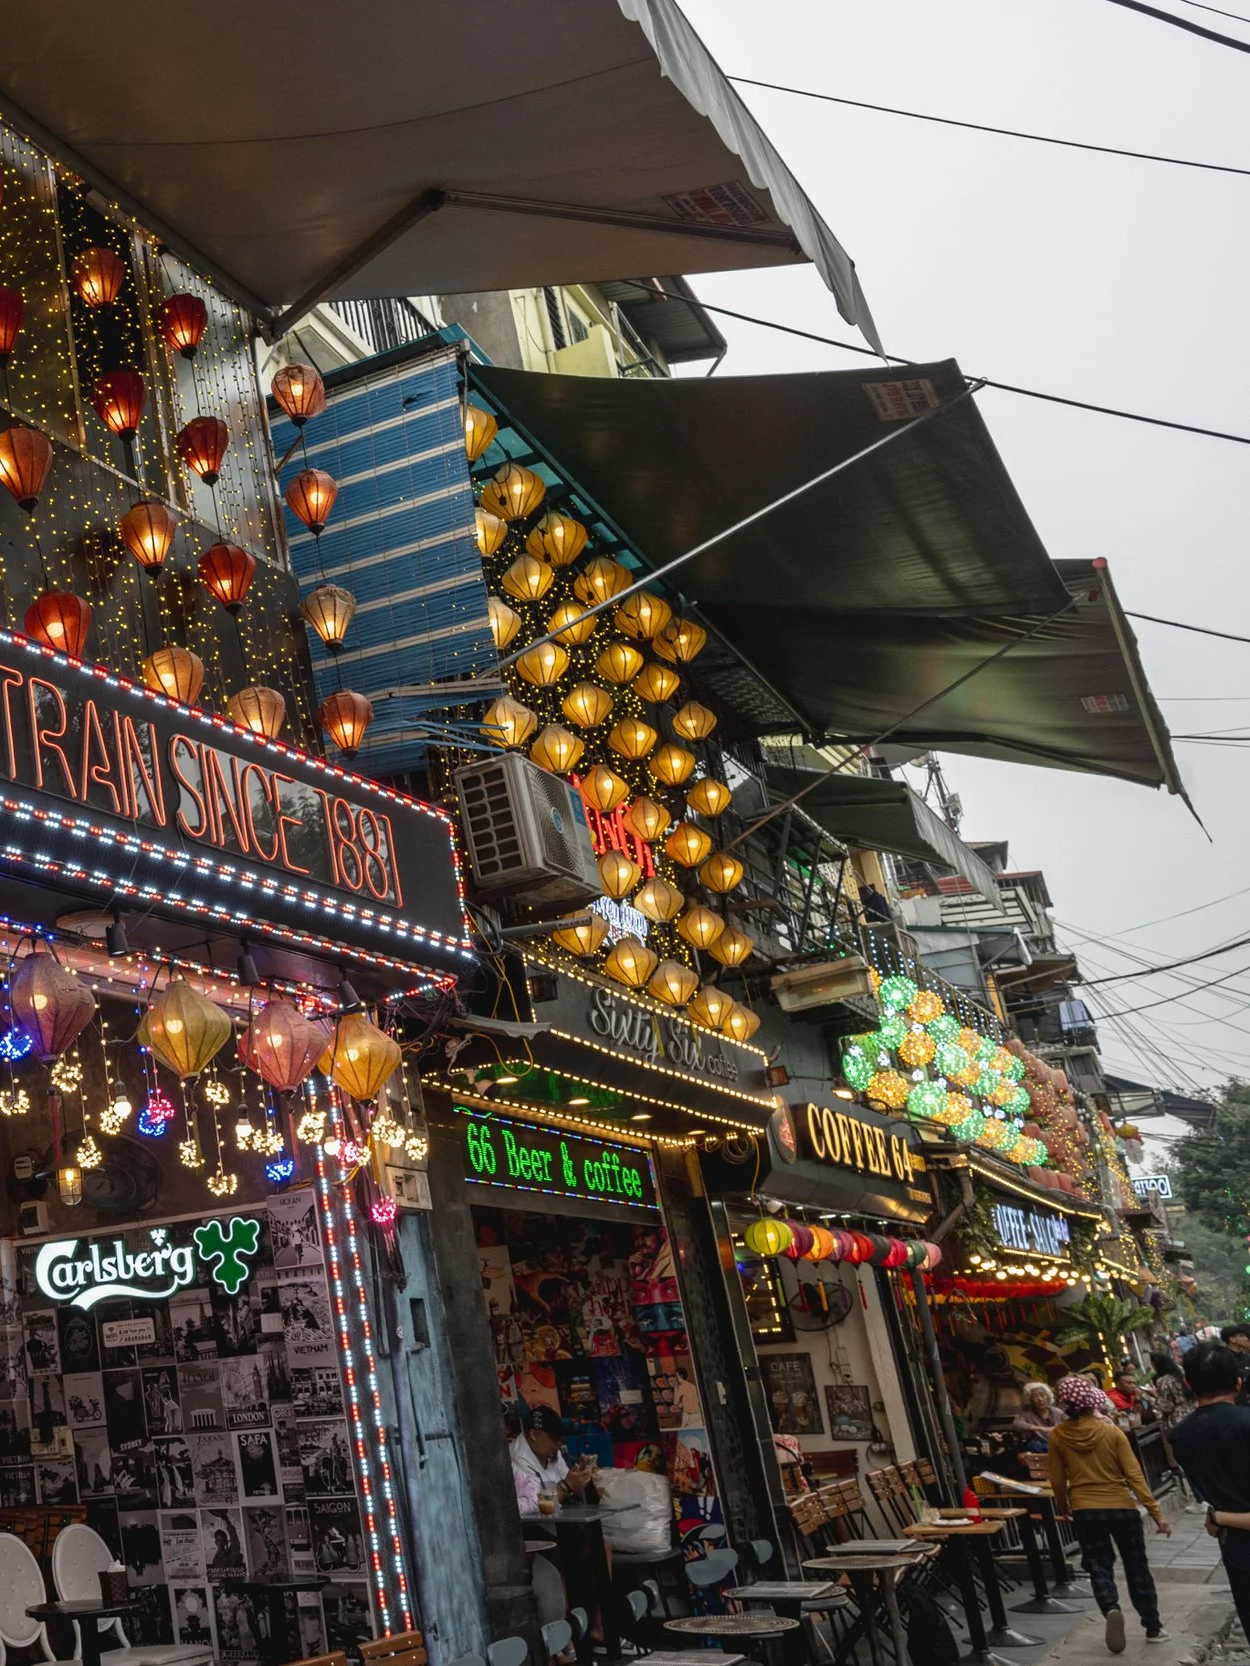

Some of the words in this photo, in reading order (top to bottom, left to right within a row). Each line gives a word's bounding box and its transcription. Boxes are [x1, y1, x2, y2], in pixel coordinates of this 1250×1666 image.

[169, 732, 311, 876] SINCE
[315, 788, 403, 909] 1881
[589, 988, 659, 1062] Sixty
[667, 1019, 706, 1071] Six
[707, 1053, 739, 1081] coffee
[467, 1122, 496, 1175] 66
[502, 1129, 553, 1182] Beer
[560, 1141, 577, 1187] &
[584, 1151, 643, 1198] coffee
[807, 1102, 892, 1177] COFFEE
[891, 1134, 914, 1182] 64
[36, 1239, 194, 1306] Carlsberg
[294, 1343, 329, 1355] VIETNAM
[119, 1439, 143, 1451] SYDNEY
[232, 1411, 265, 1424] LONDON
[314, 1502, 352, 1514] SAIGON
